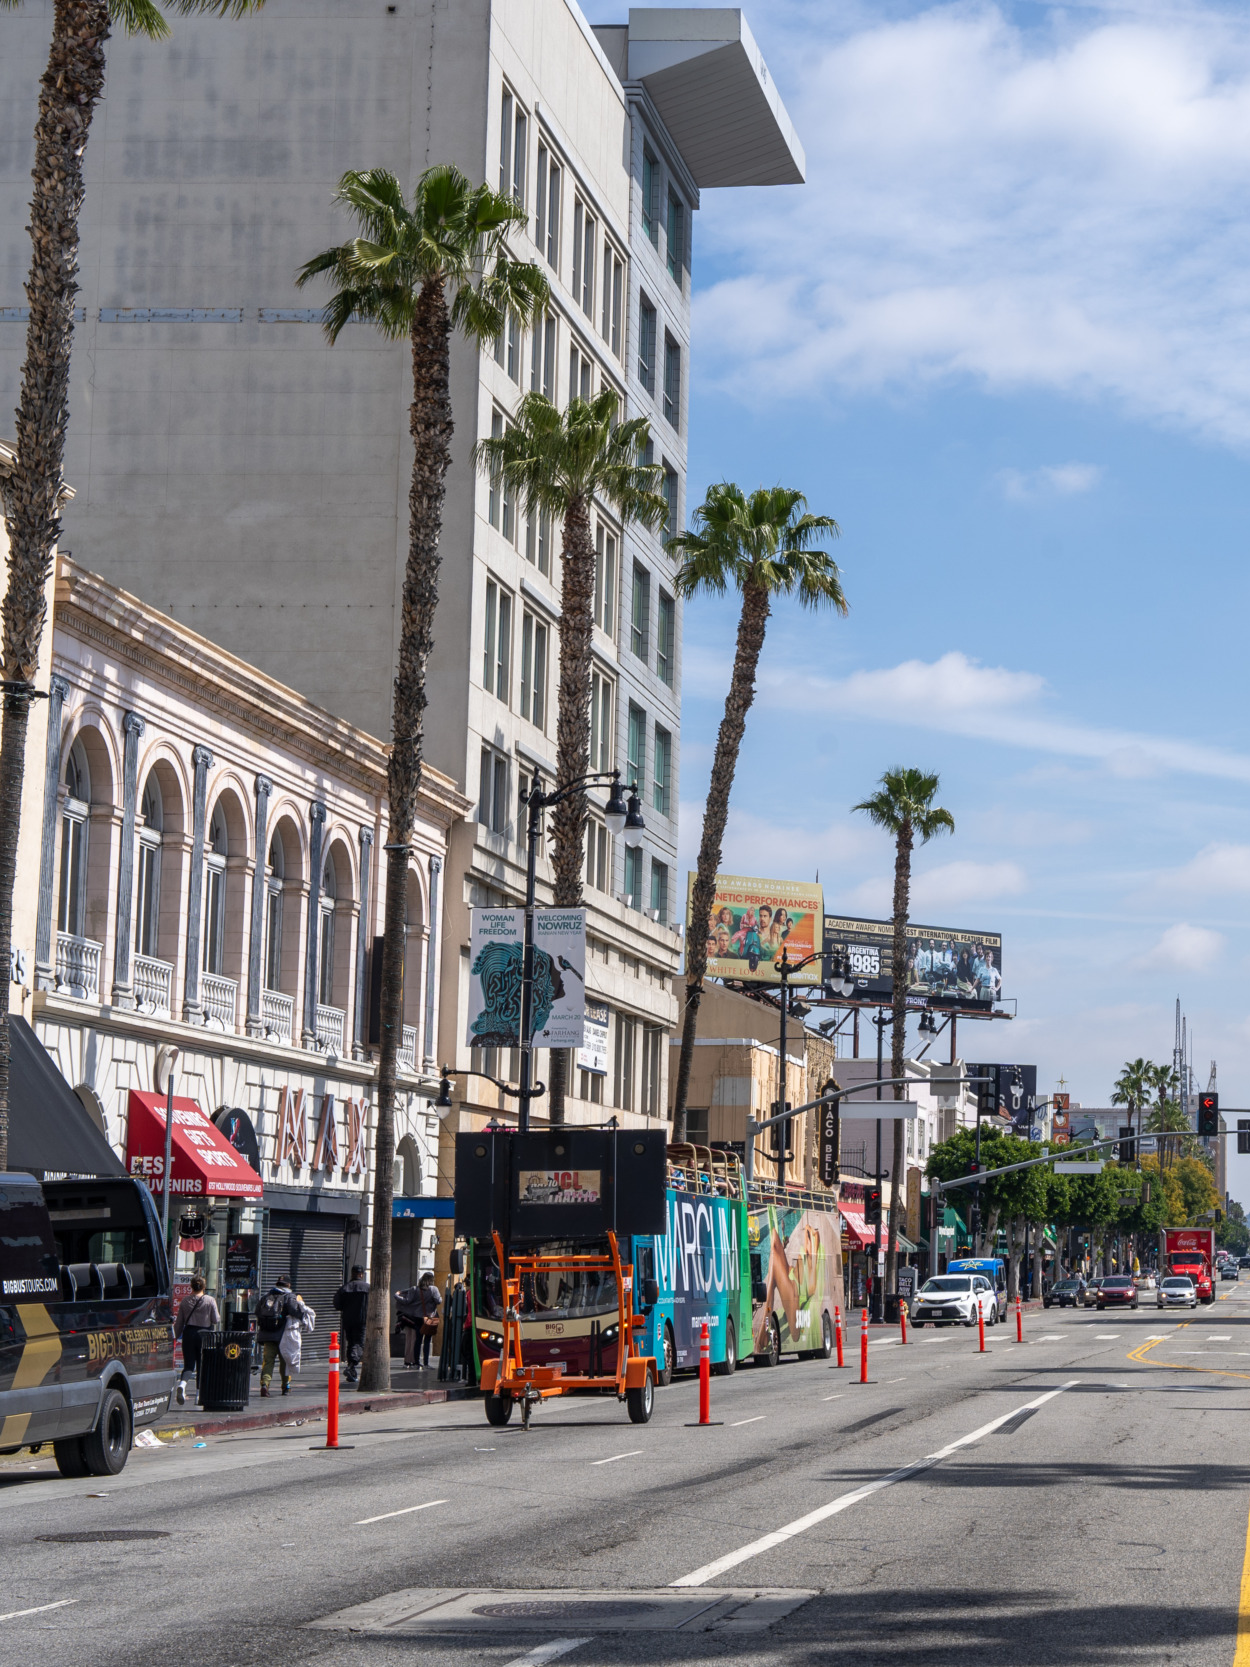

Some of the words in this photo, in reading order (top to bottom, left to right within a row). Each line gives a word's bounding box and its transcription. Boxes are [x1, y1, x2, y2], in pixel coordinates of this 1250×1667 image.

[731, 880, 762, 888] AWARDS
[744, 894, 818, 910] PERFORMANCES
[482, 914, 515, 922] WOMAN
[536, 914, 583, 922] WELCOMING
[828, 919, 854, 929] ACADEMY
[479, 928, 517, 936] FREEDOM
[537, 921, 582, 930] NOWRUZ
[907, 928, 917, 936] EST
[918, 930, 959, 941] INTERNATIONAL
[960, 934, 984, 944] FEATURE
[985, 937, 998, 945] FILM
[709, 966, 736, 975] WHITE
[850, 953, 880, 974] 1985
[825, 1101, 834, 1138] TACO
[182, 1128, 216, 1147] GIFTS
[196, 1148, 238, 1168] SPORTS
[654, 1200, 740, 1293] MARCUM
[3, 1277, 58, 1295] BIGBUSTOURS.COM
[152, 1327, 168, 1340] HOMES
